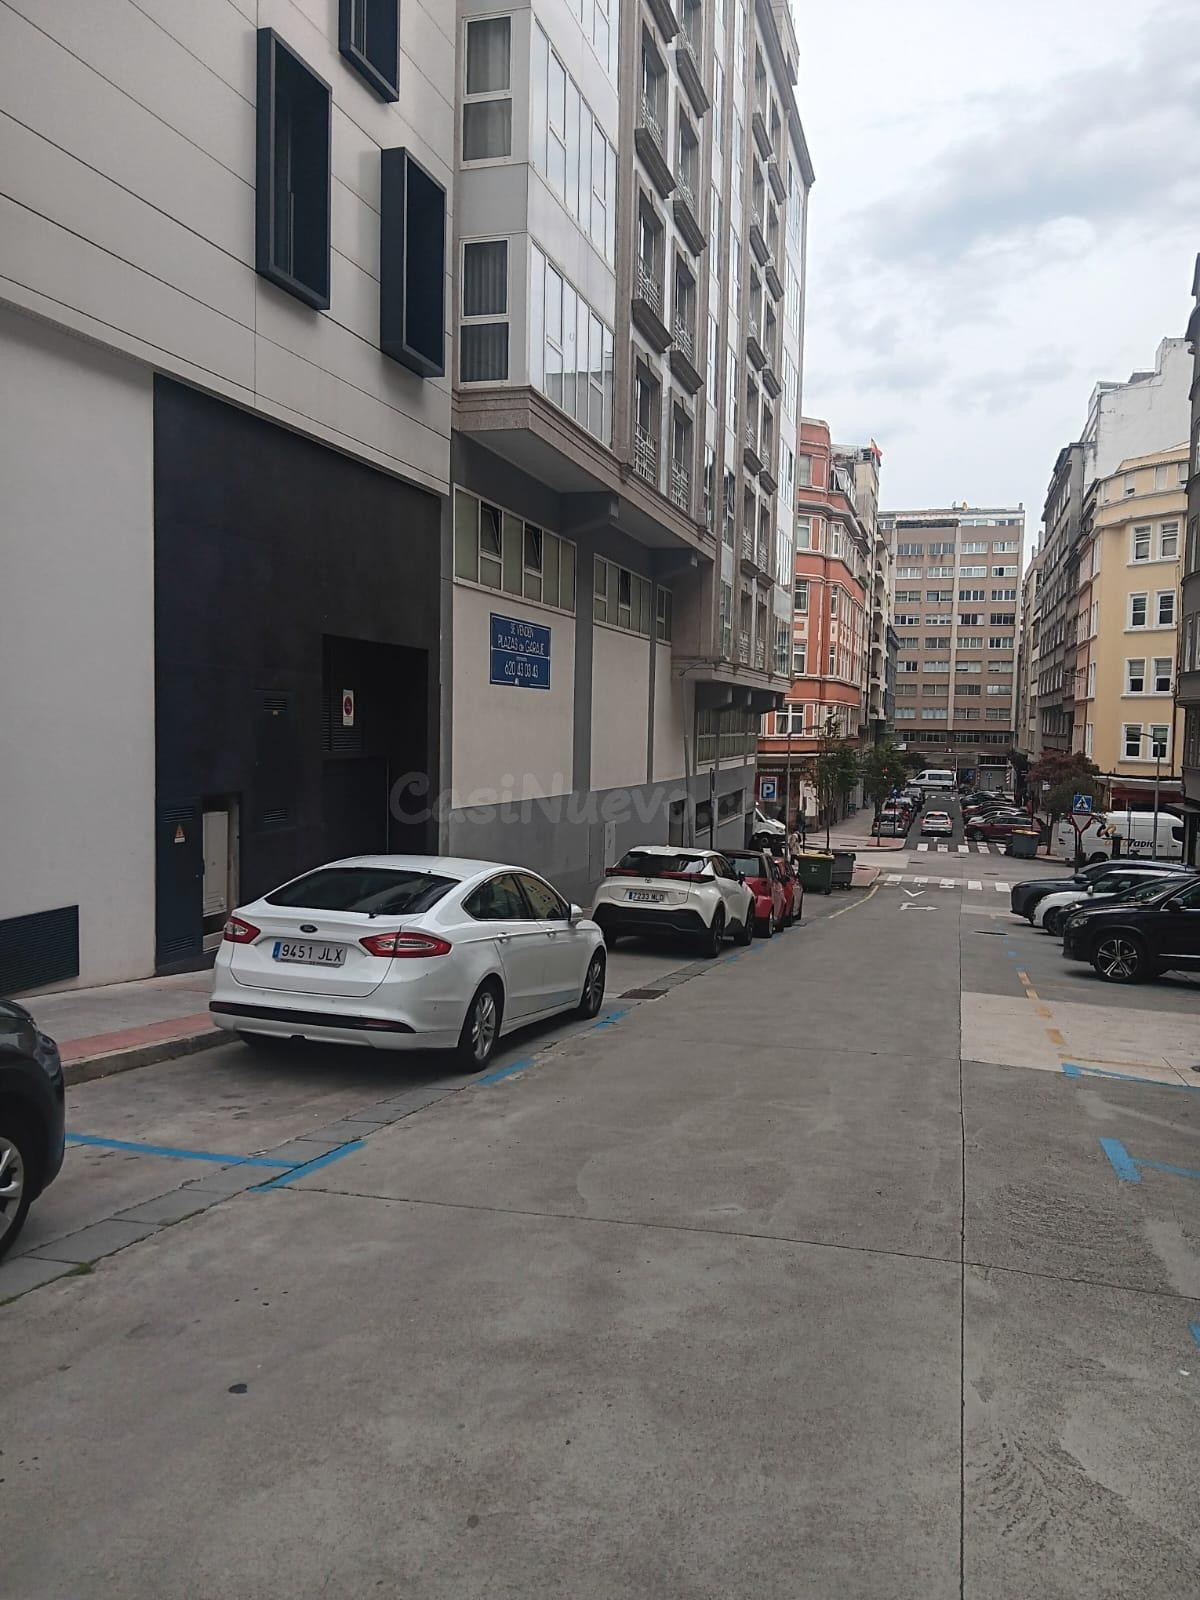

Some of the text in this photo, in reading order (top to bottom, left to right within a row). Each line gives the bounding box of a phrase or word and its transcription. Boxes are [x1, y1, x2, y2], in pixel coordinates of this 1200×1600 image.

[497, 634, 518, 650] PLAZAS
[525, 640, 544, 655] GARAJE
[505, 660, 515, 675] 620
[763, 783, 774, 797] P
[281, 944, 343, 962] 9451 JLX
